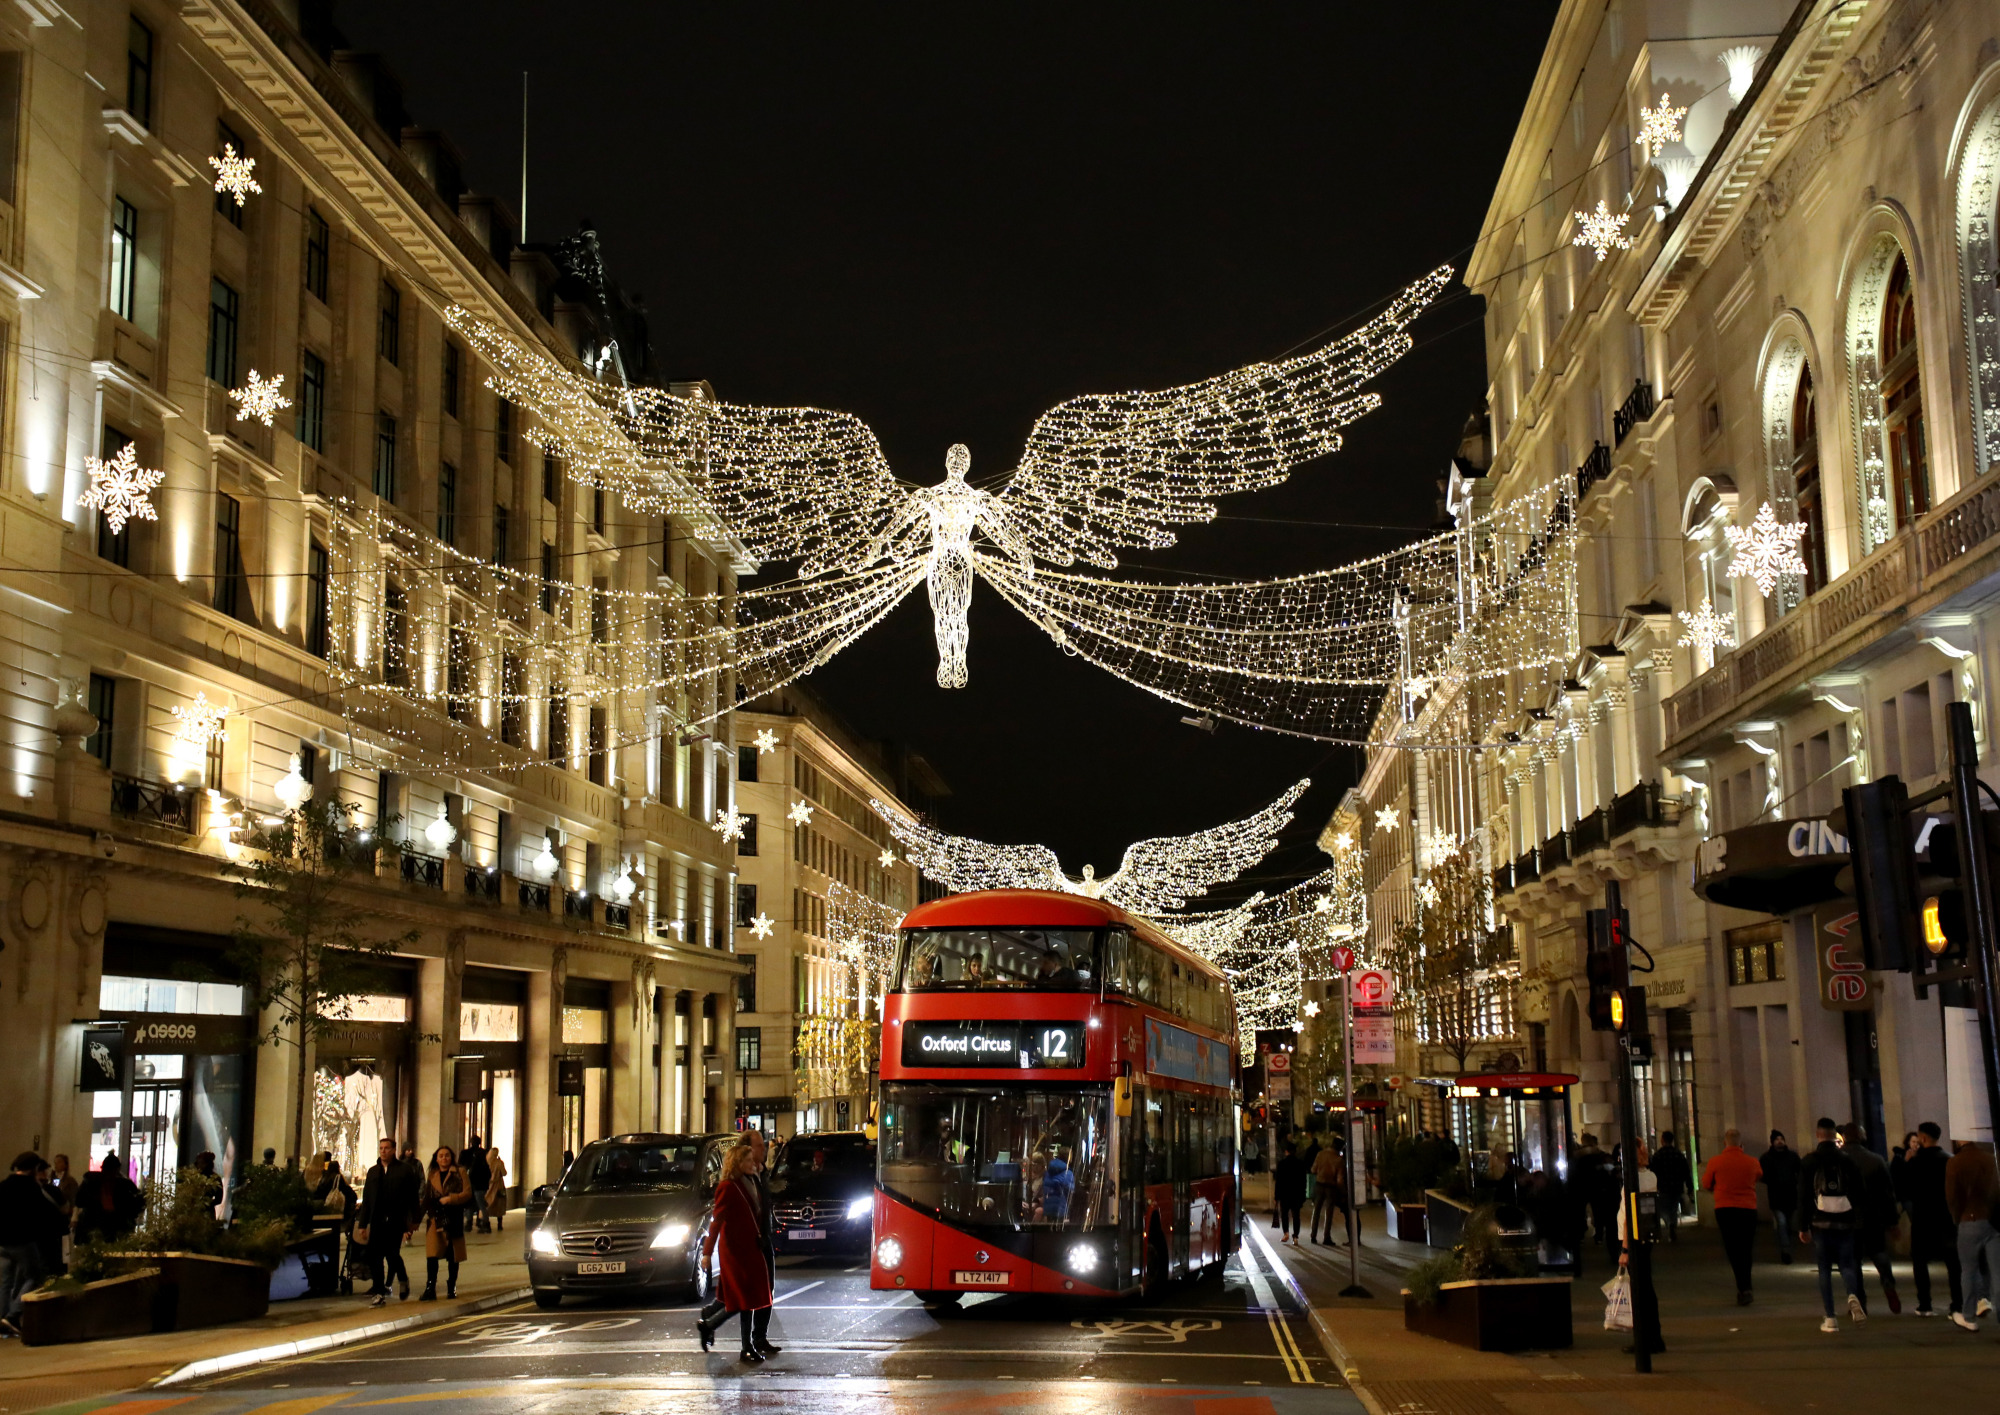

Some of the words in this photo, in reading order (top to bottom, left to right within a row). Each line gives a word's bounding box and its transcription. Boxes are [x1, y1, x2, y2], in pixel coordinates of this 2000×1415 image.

[1337, 951, 1350, 966] Y
[921, 1035, 968, 1052] Oxford
[971, 1035, 1012, 1052] Circus
[1042, 1029, 1067, 1058] 12
